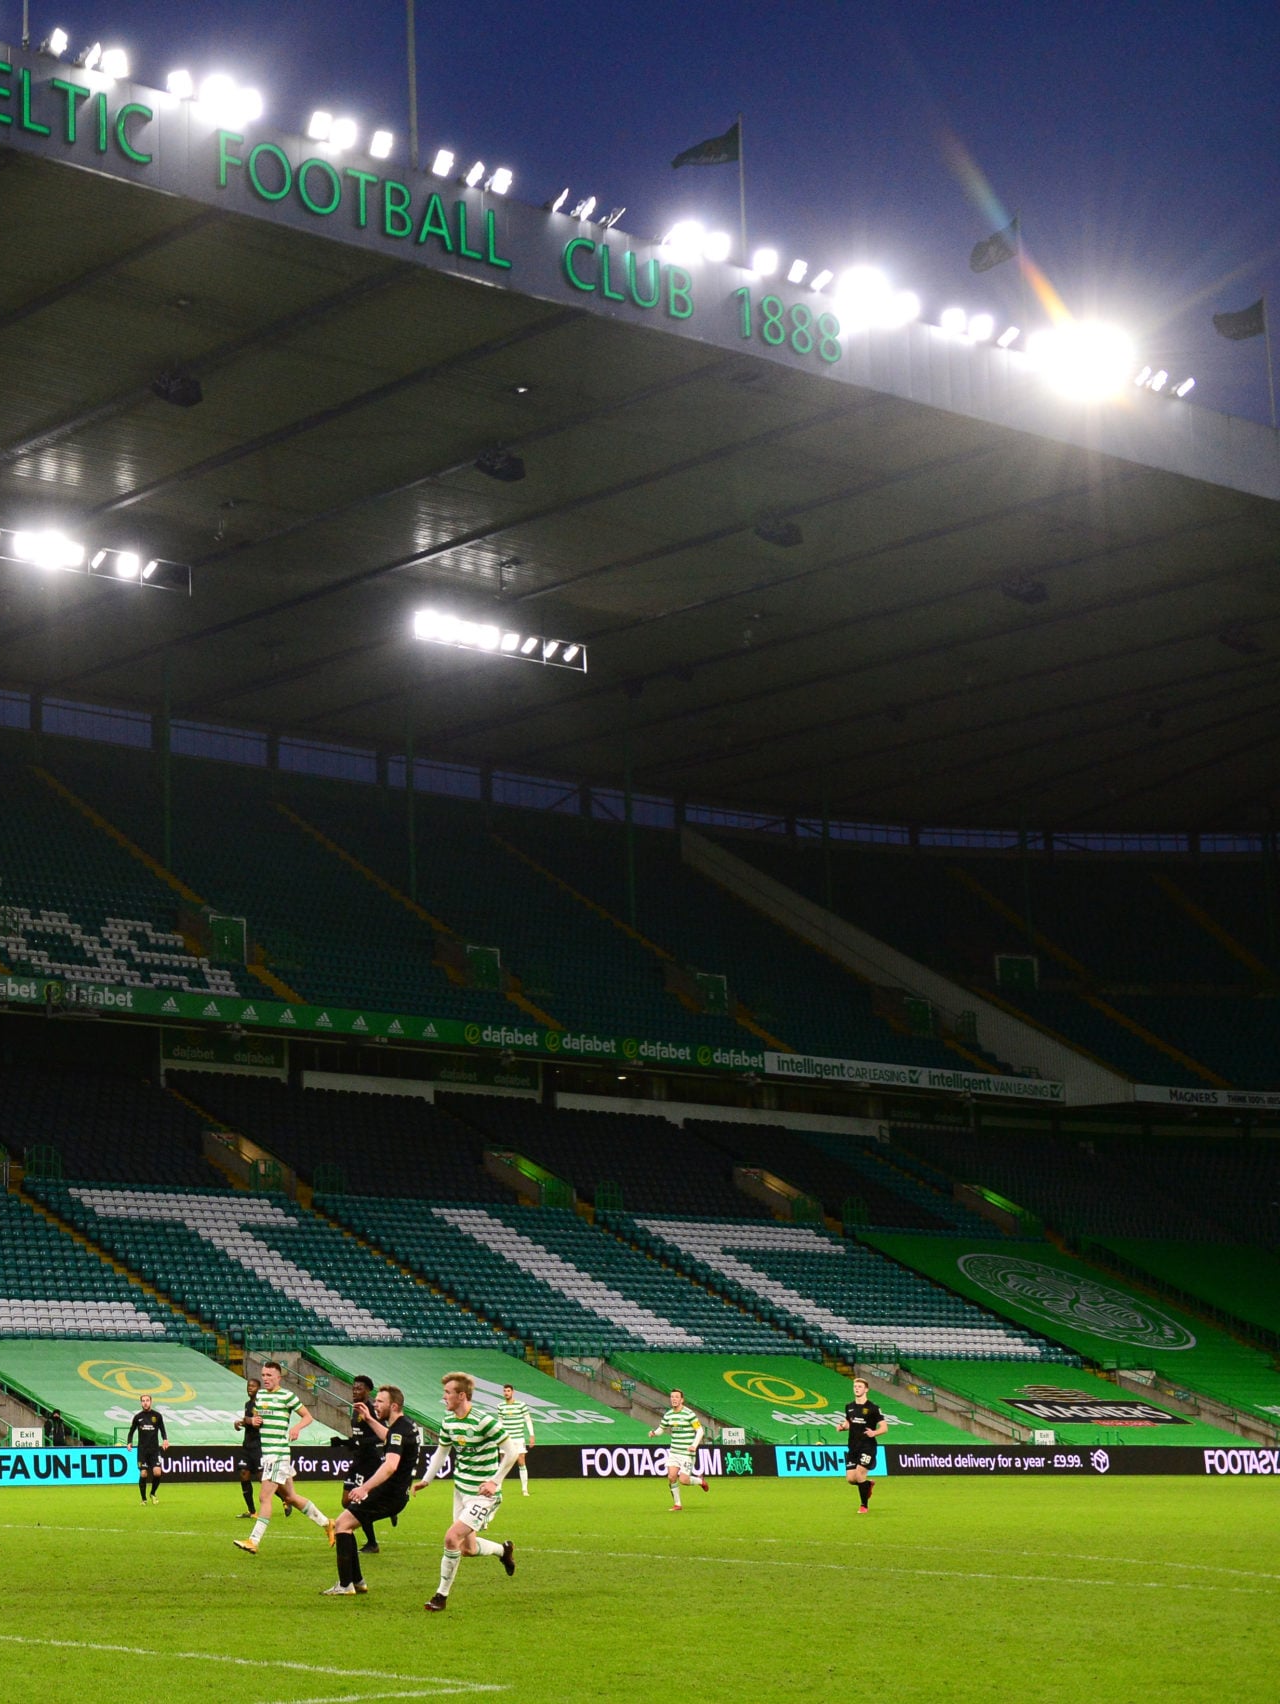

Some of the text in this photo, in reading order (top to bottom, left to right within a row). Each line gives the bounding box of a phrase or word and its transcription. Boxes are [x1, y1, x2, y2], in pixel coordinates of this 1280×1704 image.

[217, 128, 511, 269] FOOTBALL
[563, 236, 694, 320] CLUB
[734, 285, 842, 363] 1888
[65, 985, 133, 1008] dafabet
[482, 1026, 539, 1047] dafabet
[562, 1033, 616, 1053] dafabet
[639, 1040, 691, 1061] dafabet
[713, 1048, 763, 1068] dafabet
[777, 1055, 908, 1083] intelligent CAR LEASING
[928, 1070, 1050, 1098] intelligent VAN LEASING
[1169, 1088, 1218, 1104] MAGNERS
[1014, 1403, 1172, 1419] MAGNERS
[161, 1456, 234, 1472] Unlimited
[298, 1457, 319, 1472] for
[322, 1461, 329, 1472] a
[860, 1454, 871, 1464] 38
[899, 1455, 952, 1467] Unlimited
[954, 1455, 996, 1470] delivery
[997, 1456, 1012, 1467] for
[1023, 1459, 1045, 1470] year
[1053, 1456, 1083, 1468] £9.99.
[470, 1505, 488, 1521] 52
